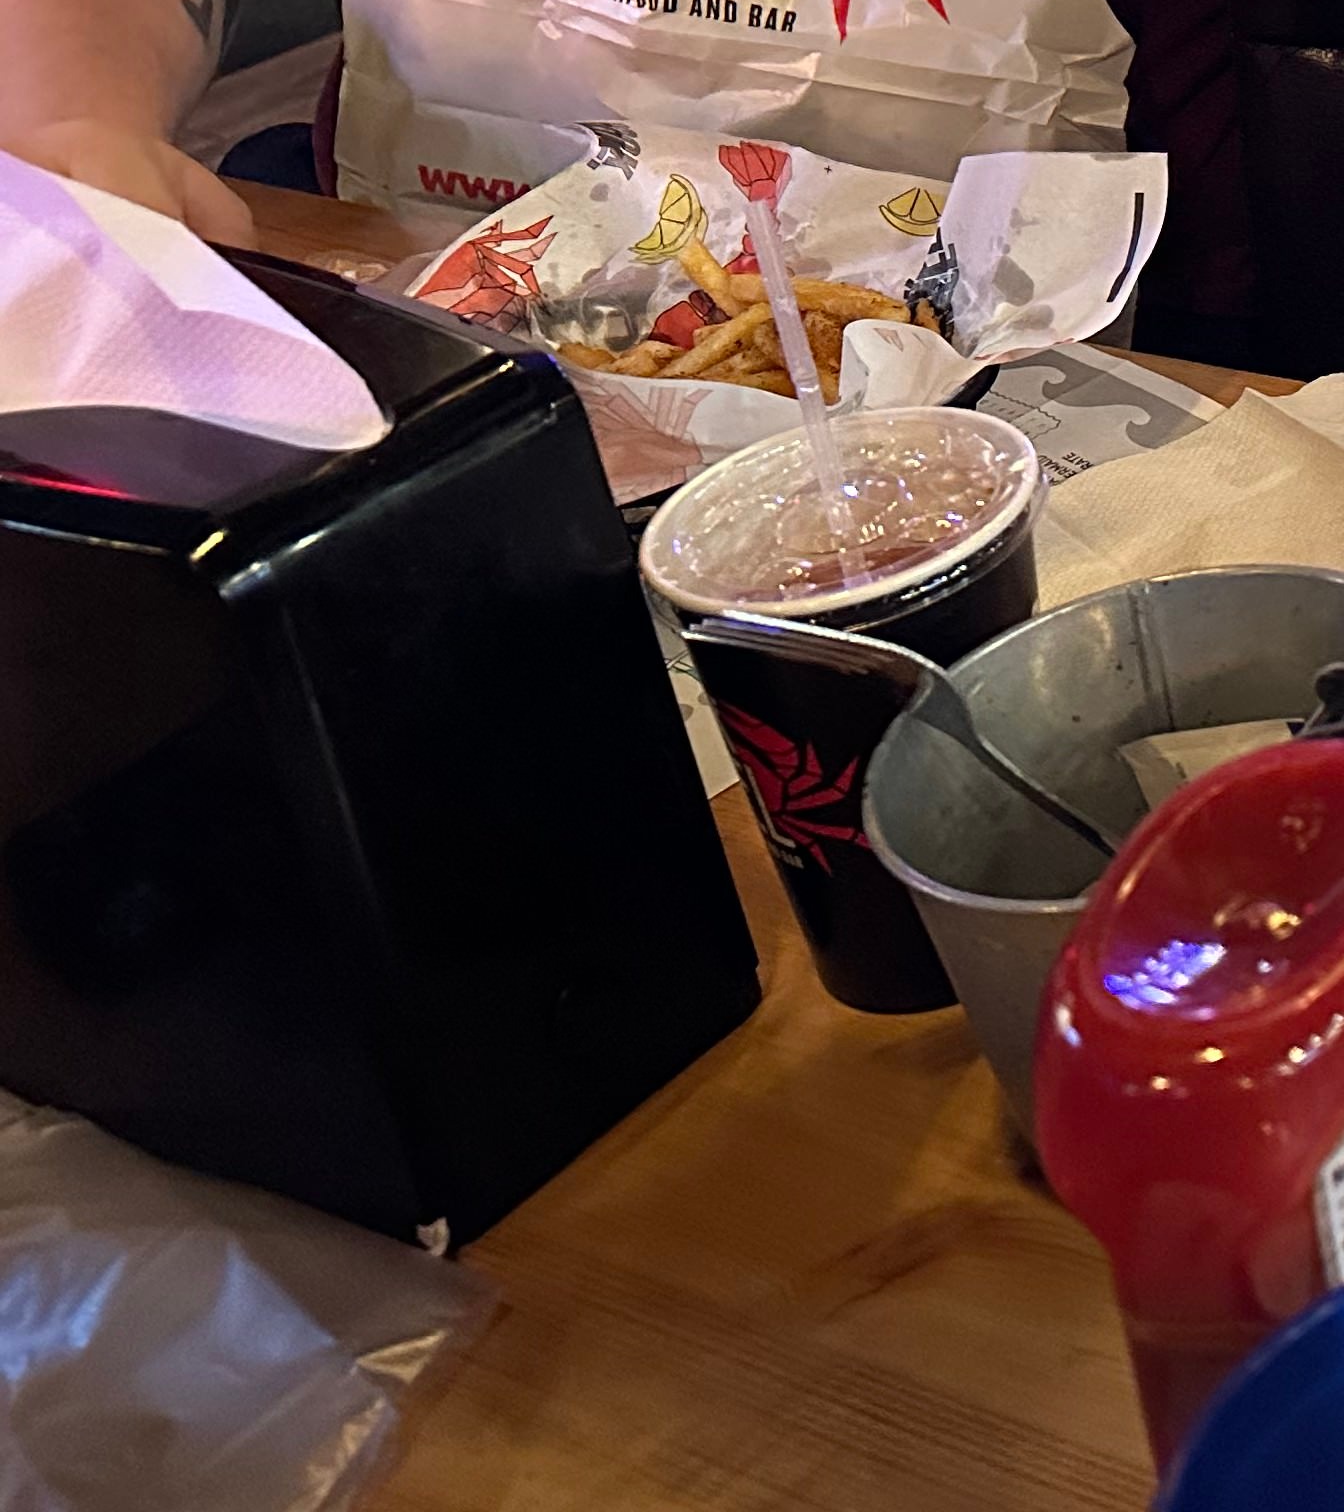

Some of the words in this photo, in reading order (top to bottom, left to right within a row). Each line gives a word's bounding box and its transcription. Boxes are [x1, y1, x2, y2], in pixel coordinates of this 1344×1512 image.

[748, 4, 797, 33] BAR
[1038, 455, 1077, 479] ERMAID
[1062, 452, 1094, 471] RATE
